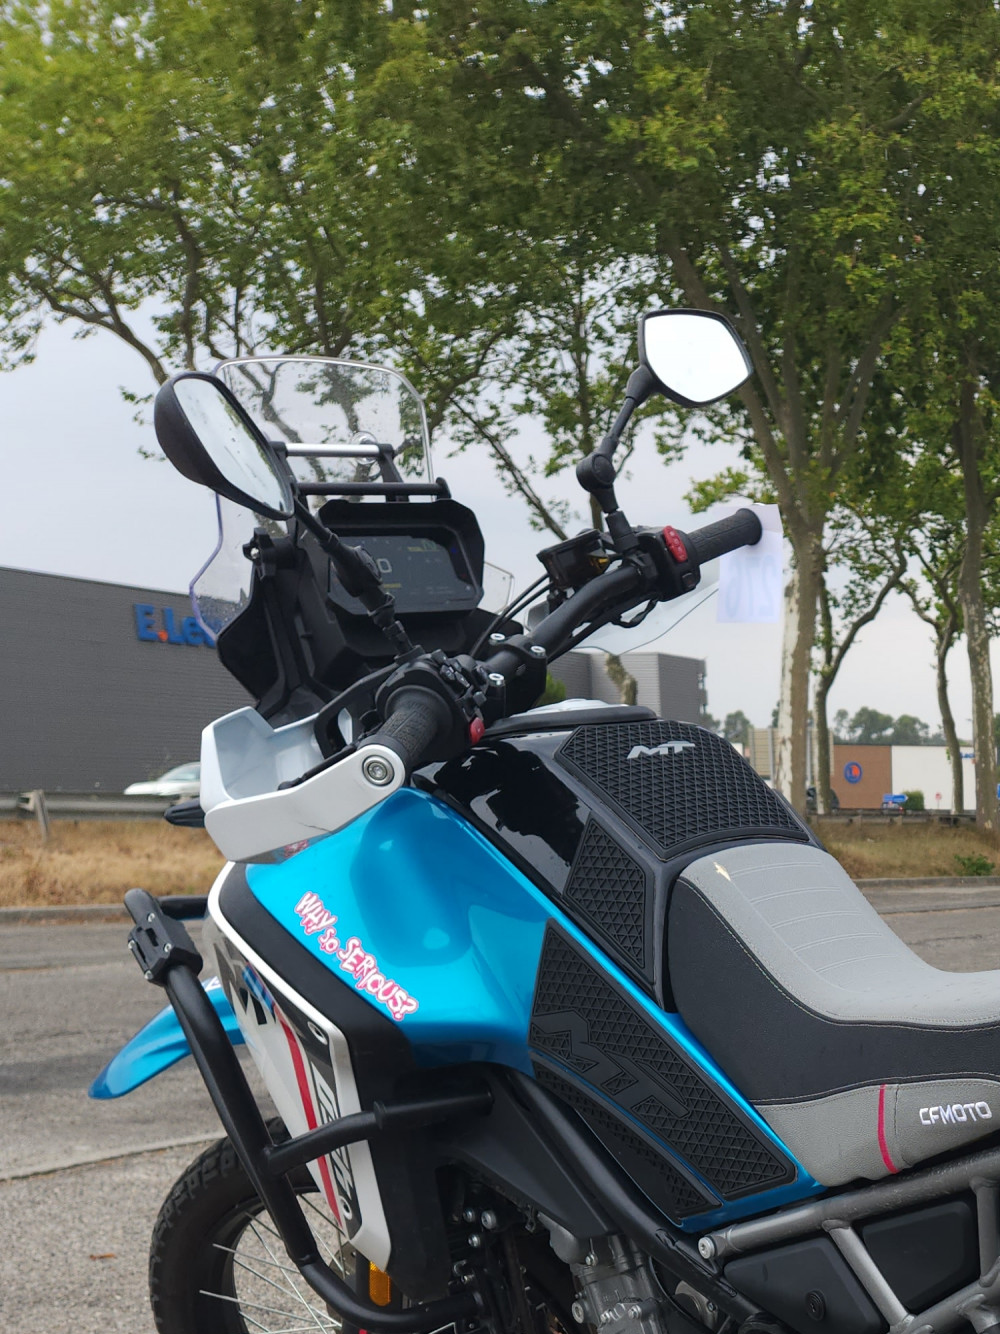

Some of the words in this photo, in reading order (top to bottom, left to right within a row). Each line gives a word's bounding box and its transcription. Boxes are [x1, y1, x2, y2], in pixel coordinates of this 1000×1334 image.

[627, 740, 695, 759] MT
[294, 891, 337, 935] WHY
[318, 927, 340, 953] SO
[336, 936, 419, 1021] SERIOUS?
[919, 1101, 992, 1126] CFMOTO
